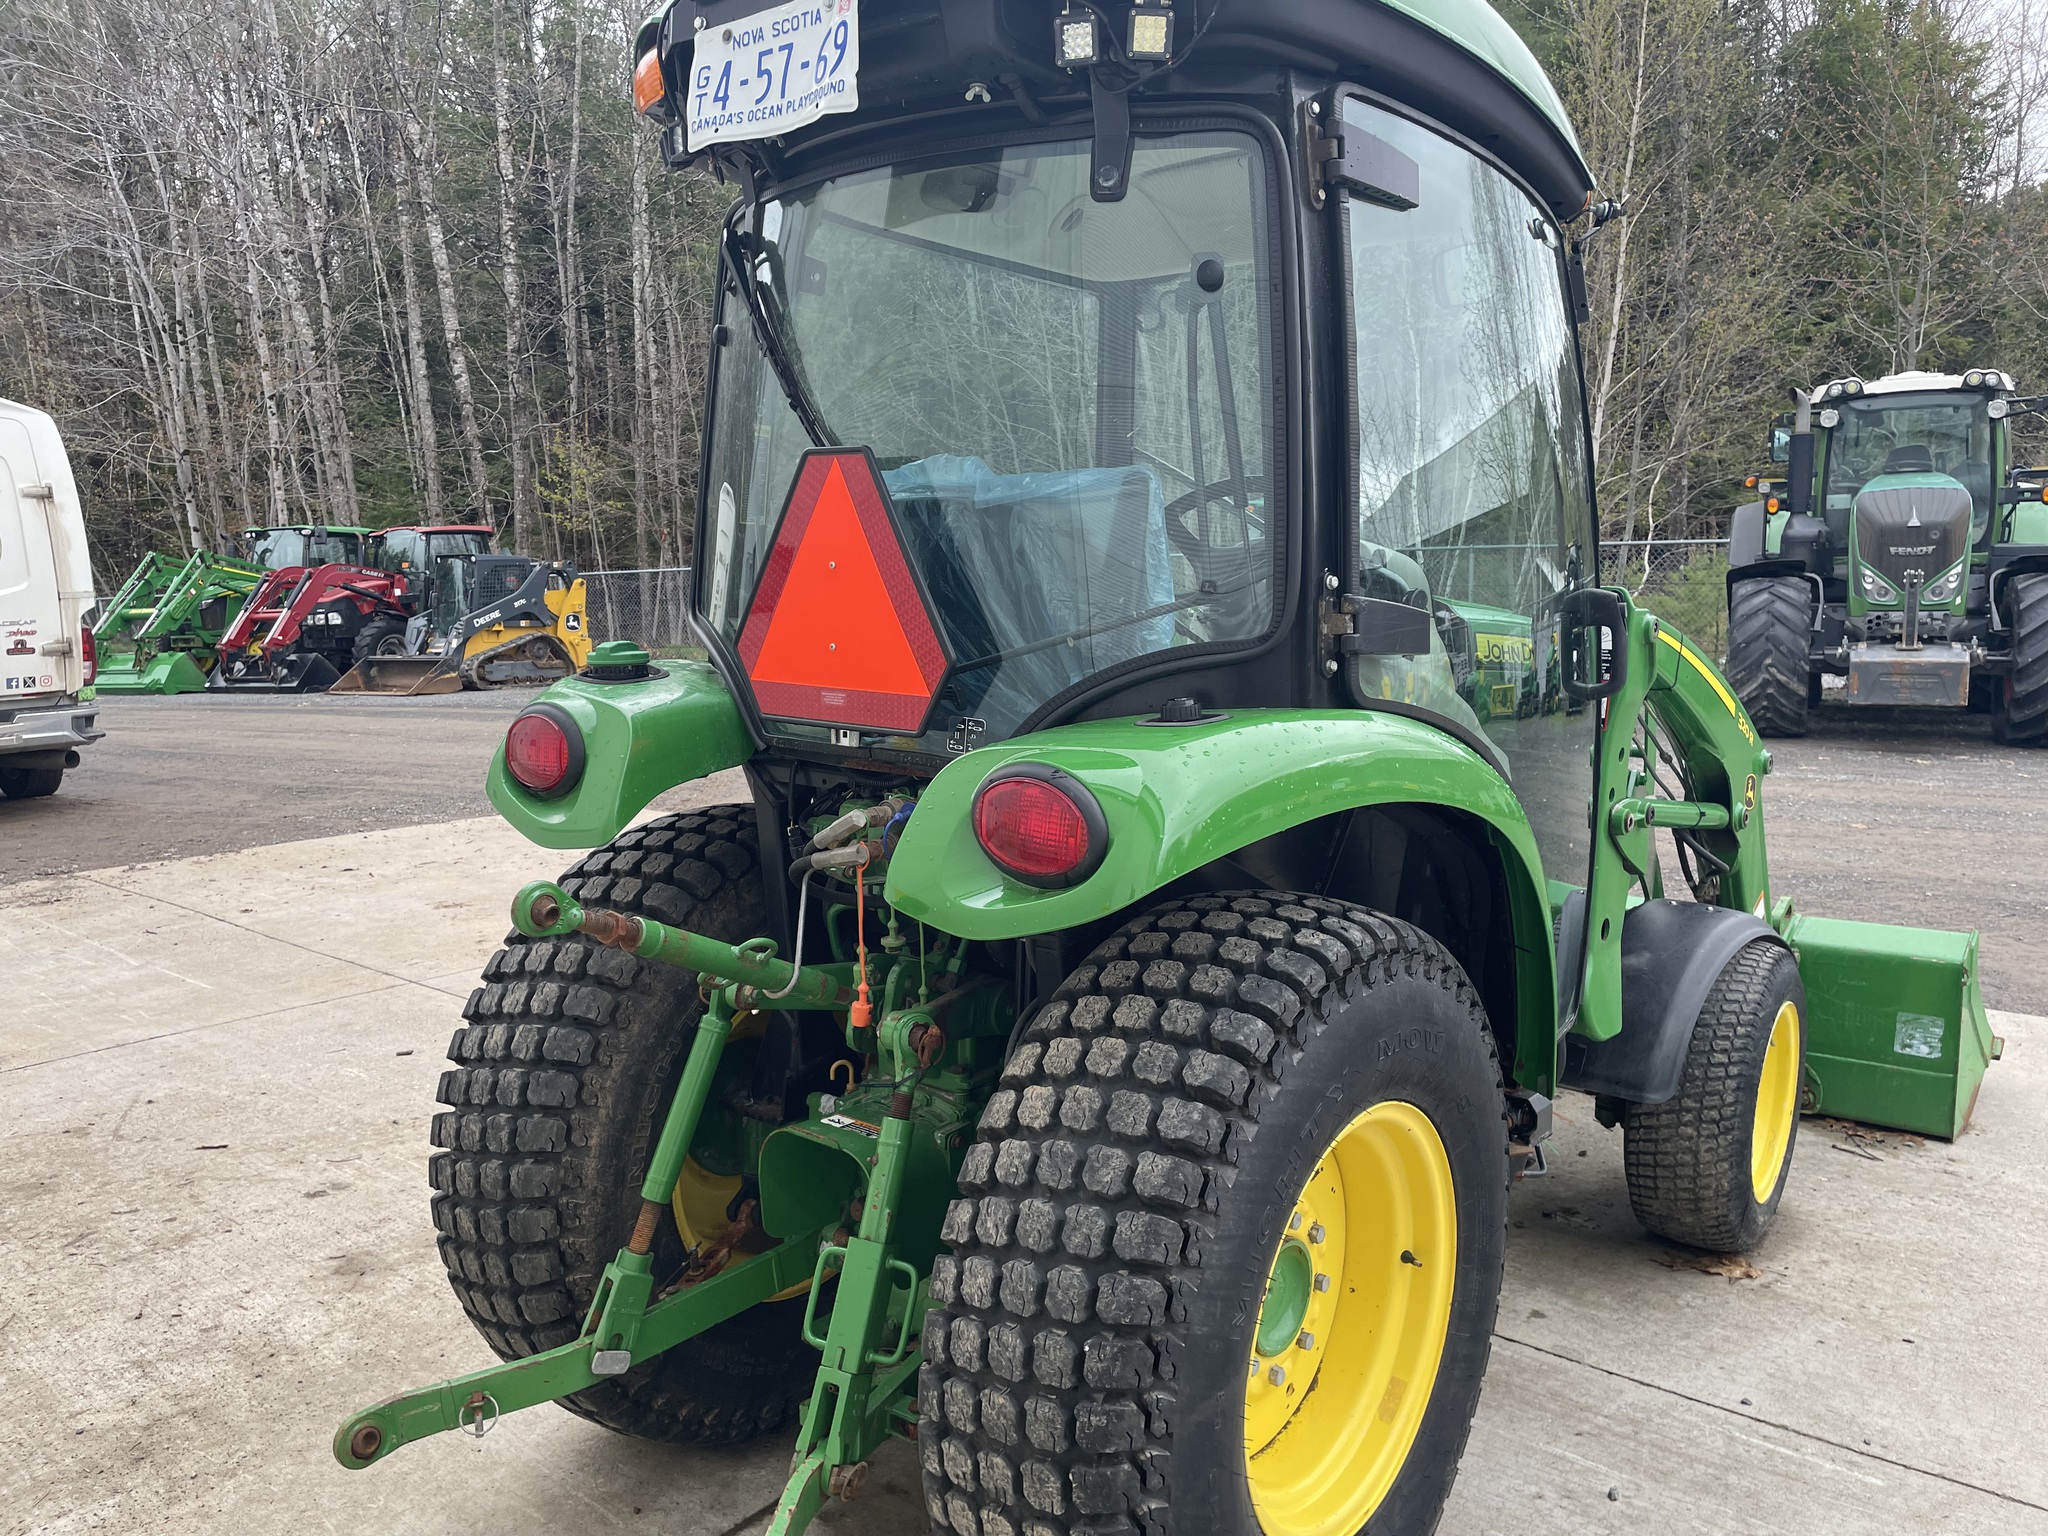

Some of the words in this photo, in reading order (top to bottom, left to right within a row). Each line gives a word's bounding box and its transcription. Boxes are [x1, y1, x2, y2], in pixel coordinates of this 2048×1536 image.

[732, 26, 765, 50] NOVA
[771, 8, 823, 38] SCOTIA
[691, 111, 744, 134] CANADA'S
[747, 105, 783, 122] OCEAN
[786, 79, 845, 114] PLAYGROUND
[1889, 545, 1937, 556] FENDT
[361, 569, 378, 577] CASE
[473, 609, 502, 628] DEERE
[1483, 639, 1520, 660] JOHN
[1377, 1026, 1446, 1061] MOW
